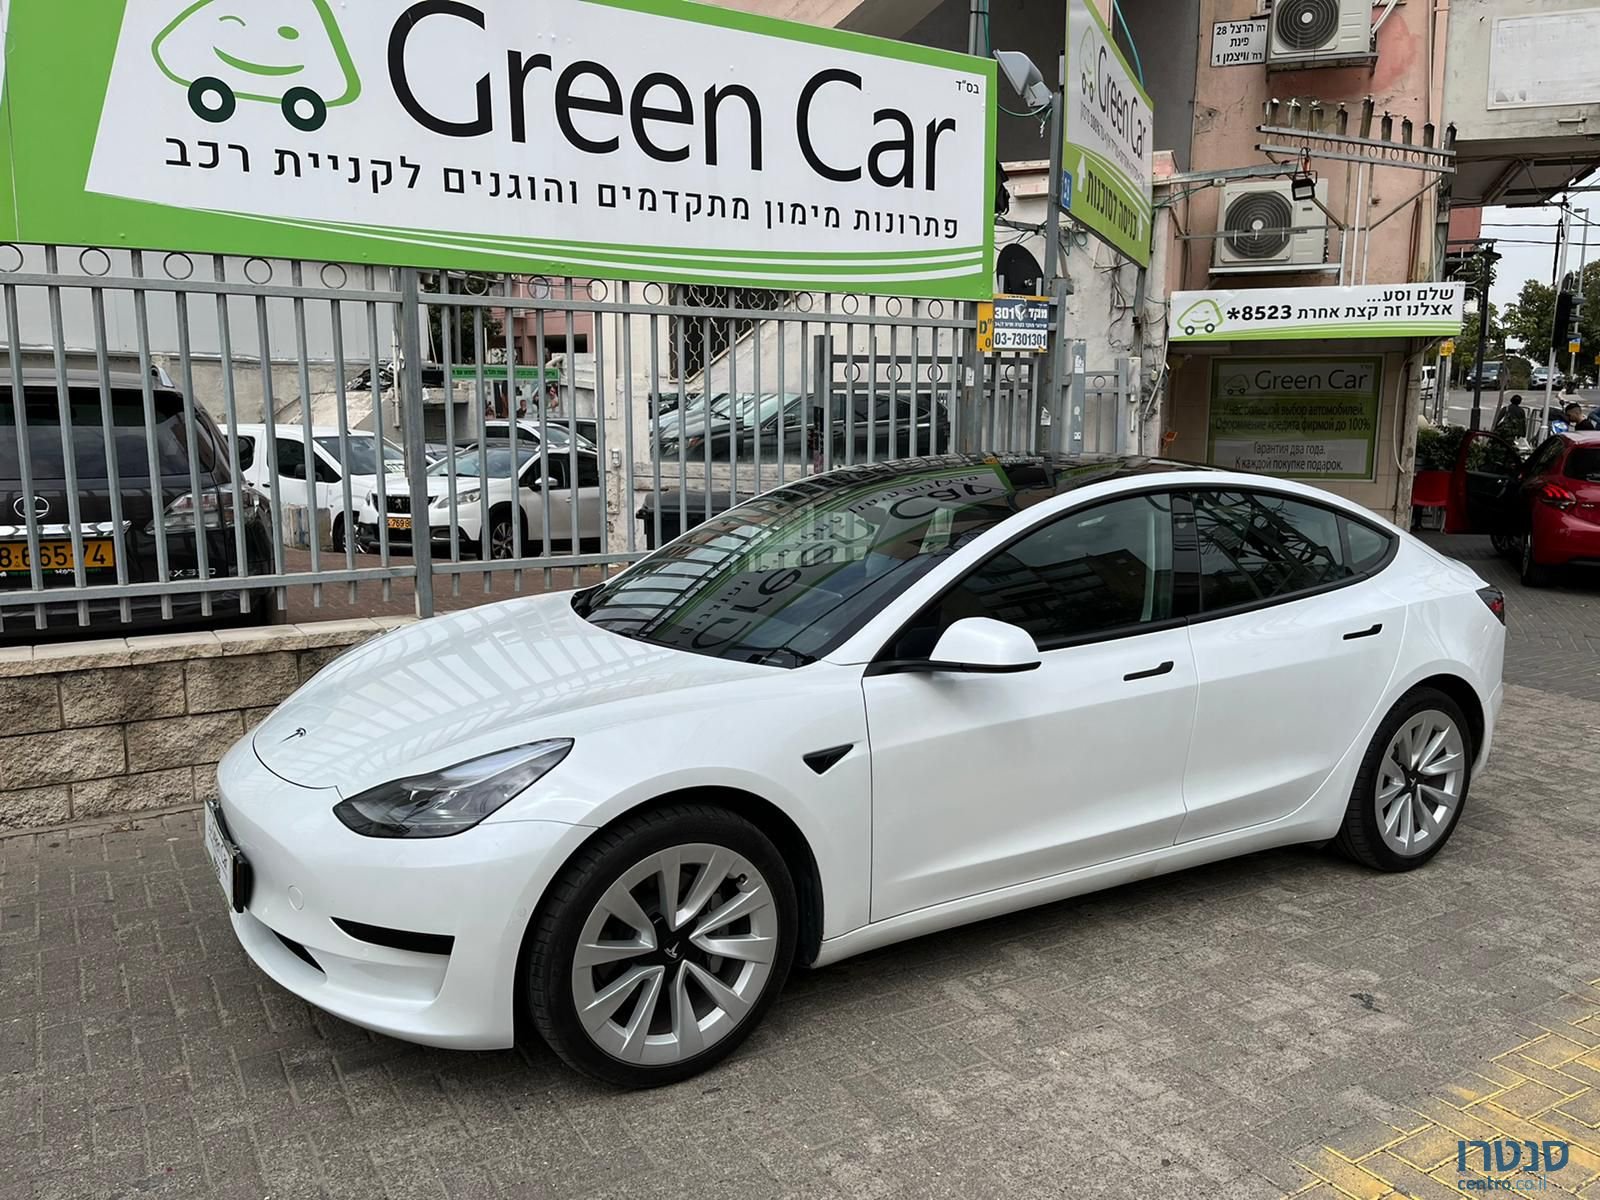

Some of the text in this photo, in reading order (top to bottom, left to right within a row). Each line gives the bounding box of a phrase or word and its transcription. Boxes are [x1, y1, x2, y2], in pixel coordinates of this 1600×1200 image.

[1216, 26, 1228, 35] 28
[1230, 23, 1254, 34] הרצל
[1230, 37, 1249, 47] פינת
[955, 80, 980, 94] בס"ד
[387, 0, 763, 171] Green
[796, 68, 956, 191] Car
[1098, 45, 1129, 143] Green
[1130, 96, 1147, 161] Car
[165, 137, 958, 238] פתרונות מימון מתקדמים והוגנים לקניית רכב
[1367, 287, 1454, 302] שלם וסע...
[994, 307, 1014, 319] 301
[1297, 307, 1340, 319] אחרת
[1344, 306, 1378, 320] קצת
[1384, 305, 1402, 317] זה
[1407, 302, 1453, 316] אצלנו
[994, 332, 1047, 346] 03-7301301
[1255, 369, 1368, 390] Green Car
[1349, 418, 1371, 431] 100%
[1254, 442, 1289, 455] Гарантия
[1290, 444, 1305, 455] два
[1273, 460, 1305, 472] покупке
